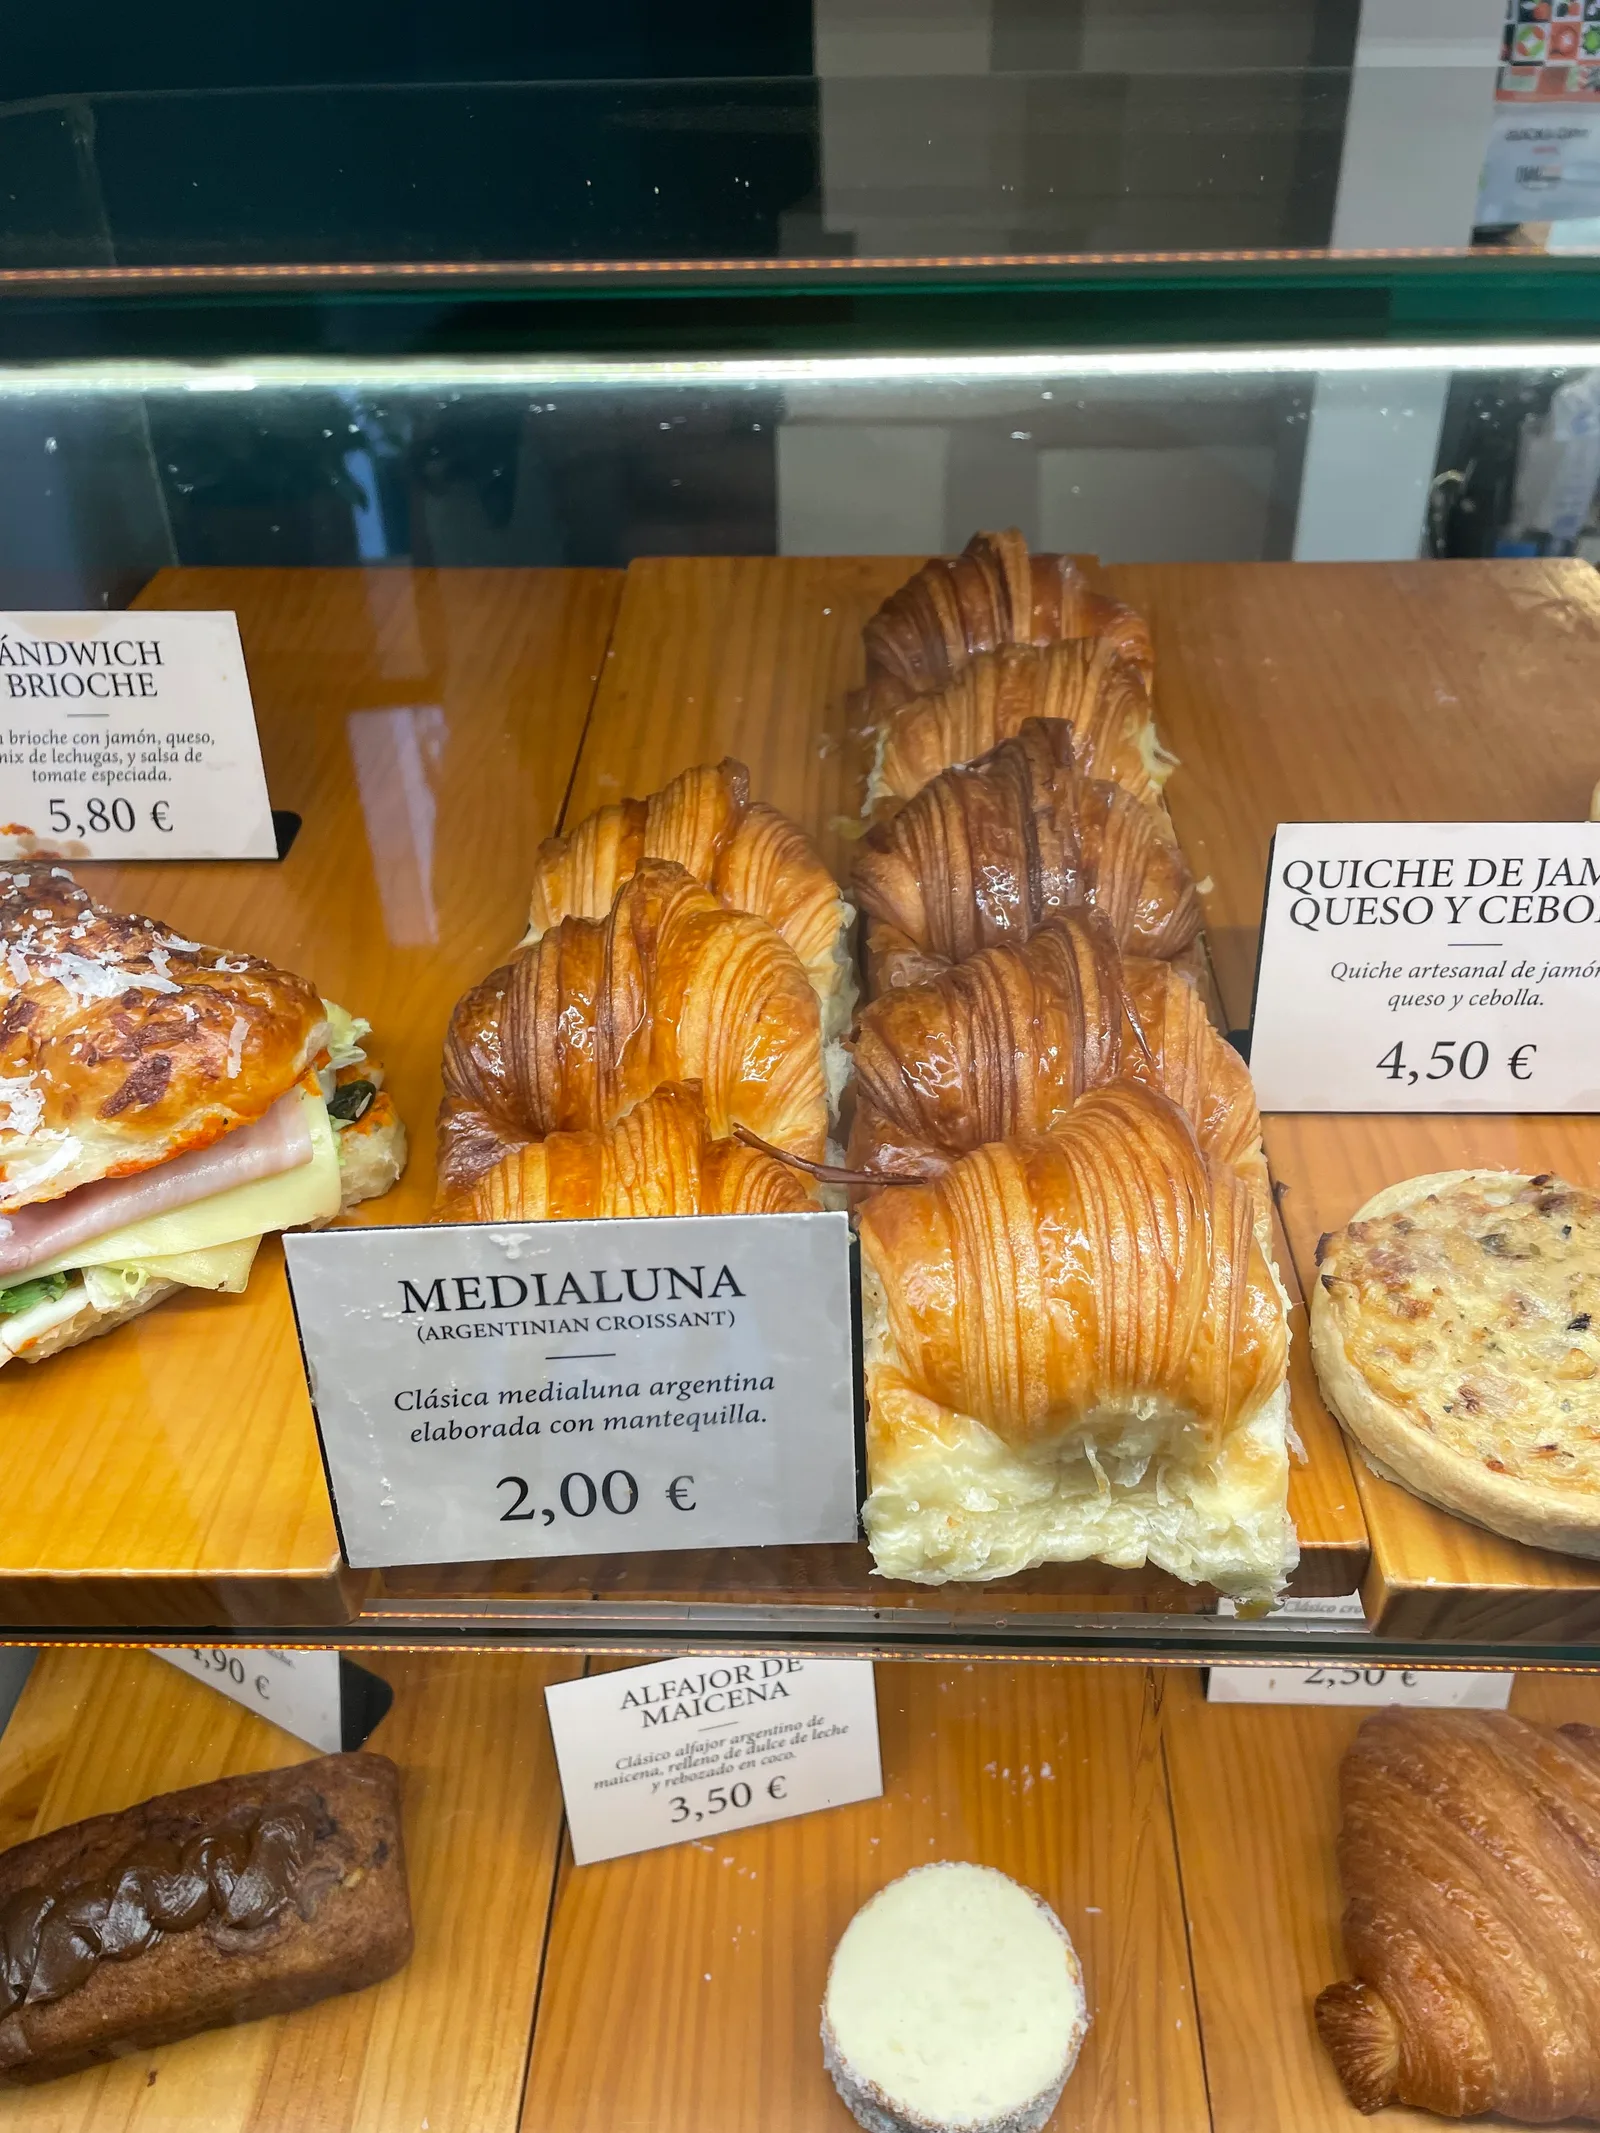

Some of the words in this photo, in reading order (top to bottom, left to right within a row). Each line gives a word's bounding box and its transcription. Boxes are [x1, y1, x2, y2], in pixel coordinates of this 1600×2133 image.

[5, 671, 158, 698] BRIOCHE
[9, 729, 68, 745] brioche
[72, 734, 100, 745] con
[105, 728, 162, 751] jamón,
[166, 733, 215, 750] queso,
[29, 748, 47, 764] de
[52, 748, 124, 768] lechugas,
[127, 754, 136, 768] y
[140, 748, 179, 764] salsa
[184, 748, 203, 763] de
[32, 770, 87, 783] tomate
[91, 768, 173, 786] especiada.
[49, 797, 136, 837] 5,80
[150, 800, 174, 833] €
[1282, 858, 1454, 895] QUICHE
[1464, 858, 1524, 888] DE
[1289, 896, 1434, 932] QUESO
[1447, 896, 1472, 925] Y
[1478, 894, 1600, 924] CEBO
[1330, 960, 1403, 982] Quiche
[1408, 960, 1505, 979] artesanal
[1511, 960, 1535, 979] de
[1388, 993, 1445, 1012] queso
[1449, 993, 1464, 1012] y
[1469, 988, 1544, 1007] cebolla.
[1376, 1040, 1489, 1086] 4,50
[1507, 1043, 1537, 1080] €
[397, 1263, 746, 1314] MEDIALUNA
[417, 1316, 590, 1345] (ARGENTINIAN
[596, 1309, 736, 1332] CROISSANT)
[394, 1386, 490, 1412] Clásica
[498, 1378, 641, 1405] medialuna
[649, 1373, 775, 1401] argentina
[410, 1414, 541, 1443] elaborada
[549, 1416, 595, 1435] con
[603, 1403, 768, 1433] mantequilla.
[496, 1469, 640, 1527] 2,00
[665, 1475, 698, 1511] €
[1284, 1600, 1336, 1613] Clásico
[255, 1675, 270, 1700] €
[619, 1664, 754, 1710] ALFAJOR
[760, 1658, 804, 1679] DE
[641, 1681, 790, 1728] MAICENA
[615, 1751, 671, 1770] Clásico
[675, 1738, 727, 1757] alfajor
[730, 1722, 803, 1745] argentino
[807, 1715, 825, 1728] de
[668, 1752, 720, 1773] relleno
[723, 1746, 742, 1760] de
[745, 1738, 787, 1755] dulce
[789, 1732, 808, 1745] de
[812, 1724, 849, 1740] leche
[651, 1781, 662, 1794] y
[664, 1762, 735, 1787] rebozado
[738, 1760, 756, 1771] en
[760, 1751, 797, 1766] coco.
[668, 1782, 752, 1823] 3,50
[767, 1775, 788, 1800] €
